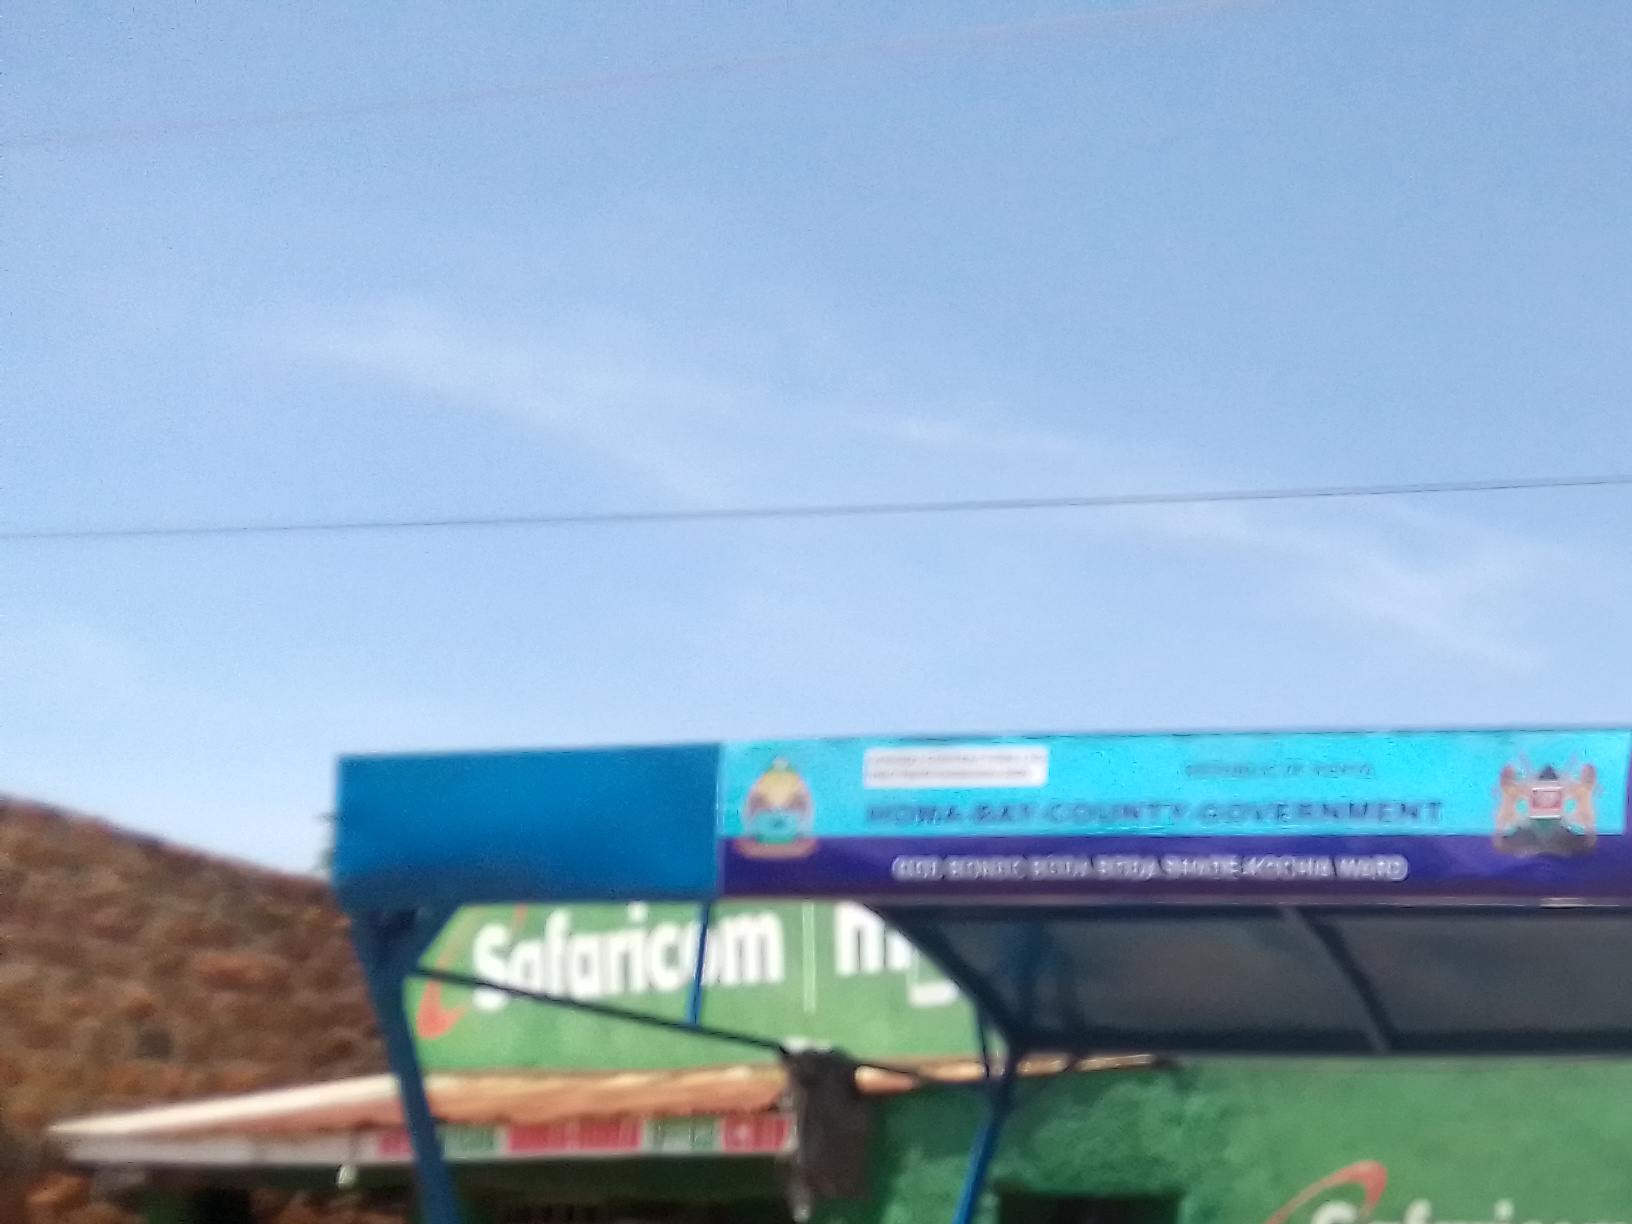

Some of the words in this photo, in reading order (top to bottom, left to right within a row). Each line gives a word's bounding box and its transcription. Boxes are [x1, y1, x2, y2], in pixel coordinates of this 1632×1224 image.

[1046, 802, 1182, 824] COUNTY
[1200, 801, 1443, 824] GOVERNMENT
[473, 902, 786, 1012] Safaricom
